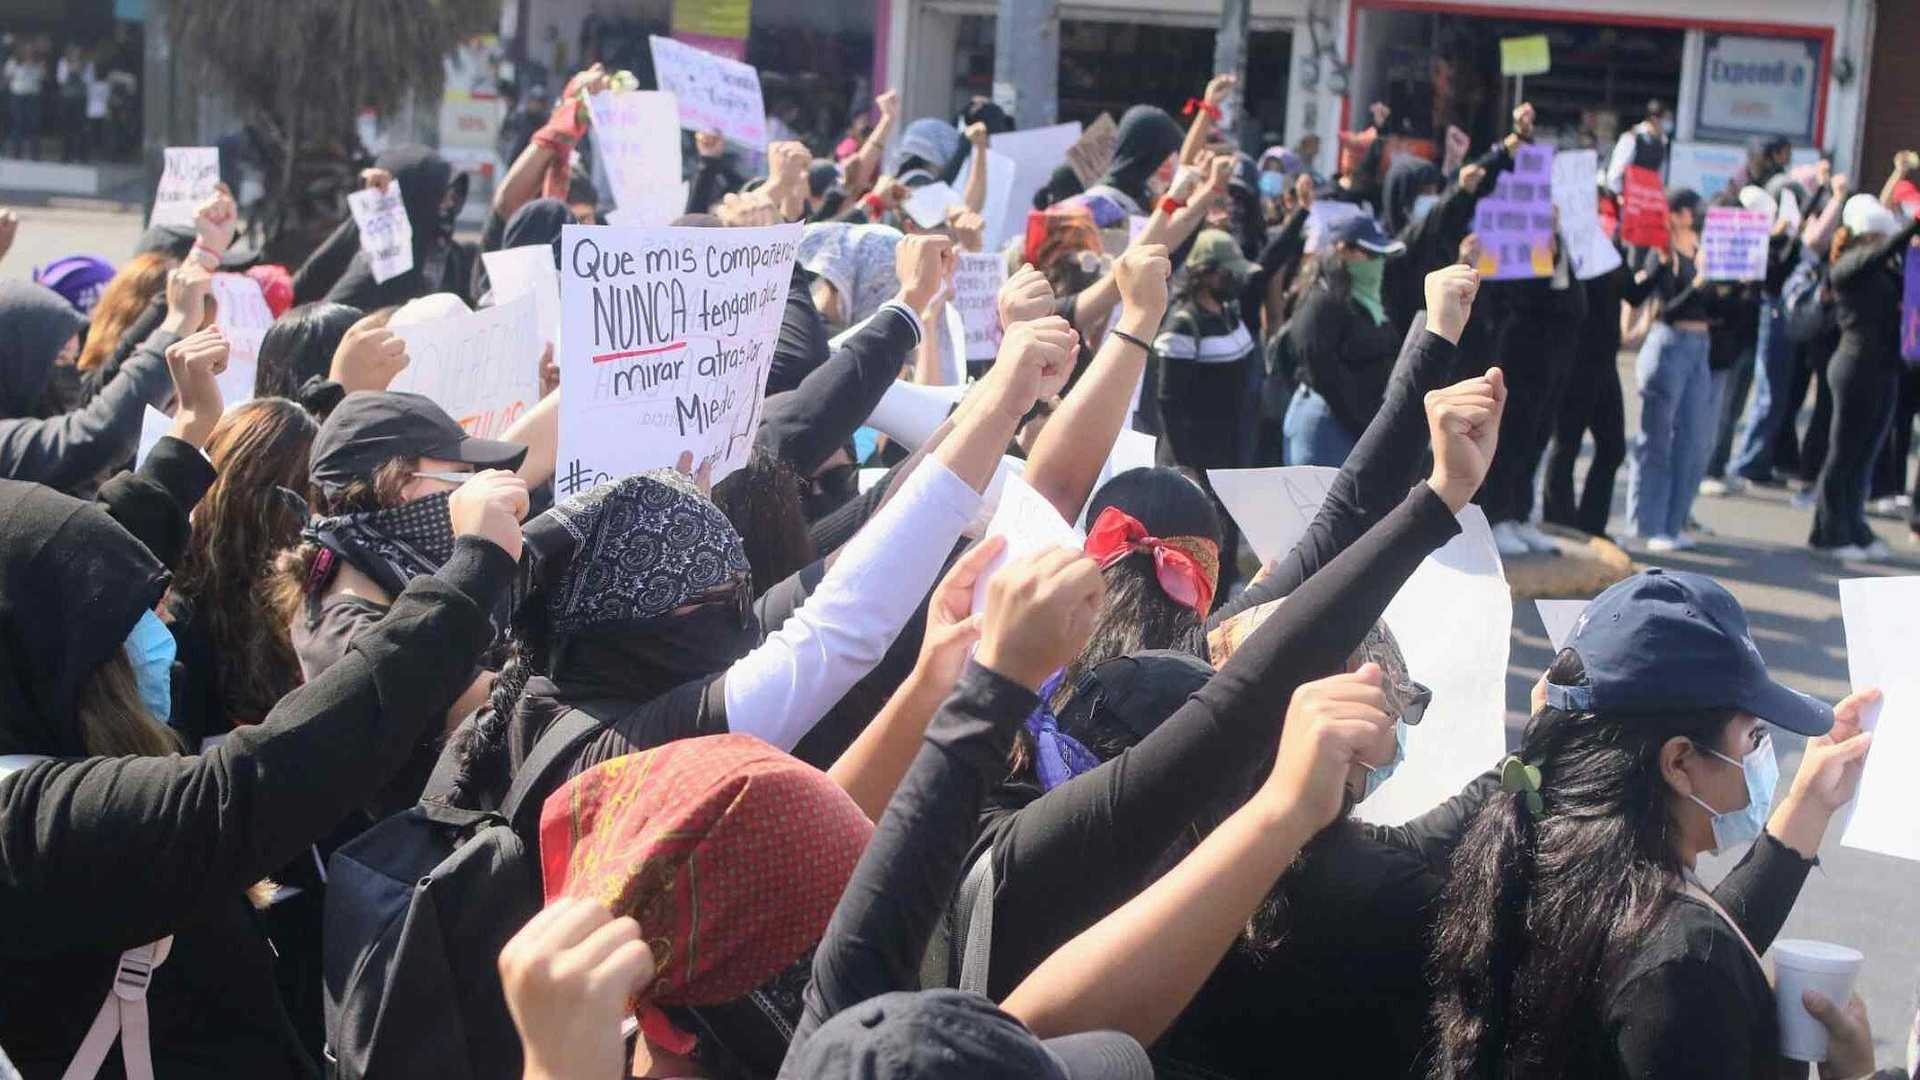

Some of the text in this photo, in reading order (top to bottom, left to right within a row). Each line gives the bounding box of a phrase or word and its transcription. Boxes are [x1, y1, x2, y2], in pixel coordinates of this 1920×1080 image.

[572, 238, 635, 282] Que
[646, 246, 697, 274] mis
[592, 277, 687, 350] NUNCA
[698, 288, 757, 337] tengan
[614, 360, 684, 396] mirar
[698, 340, 745, 377] atras
[675, 385, 735, 437] Miedo
